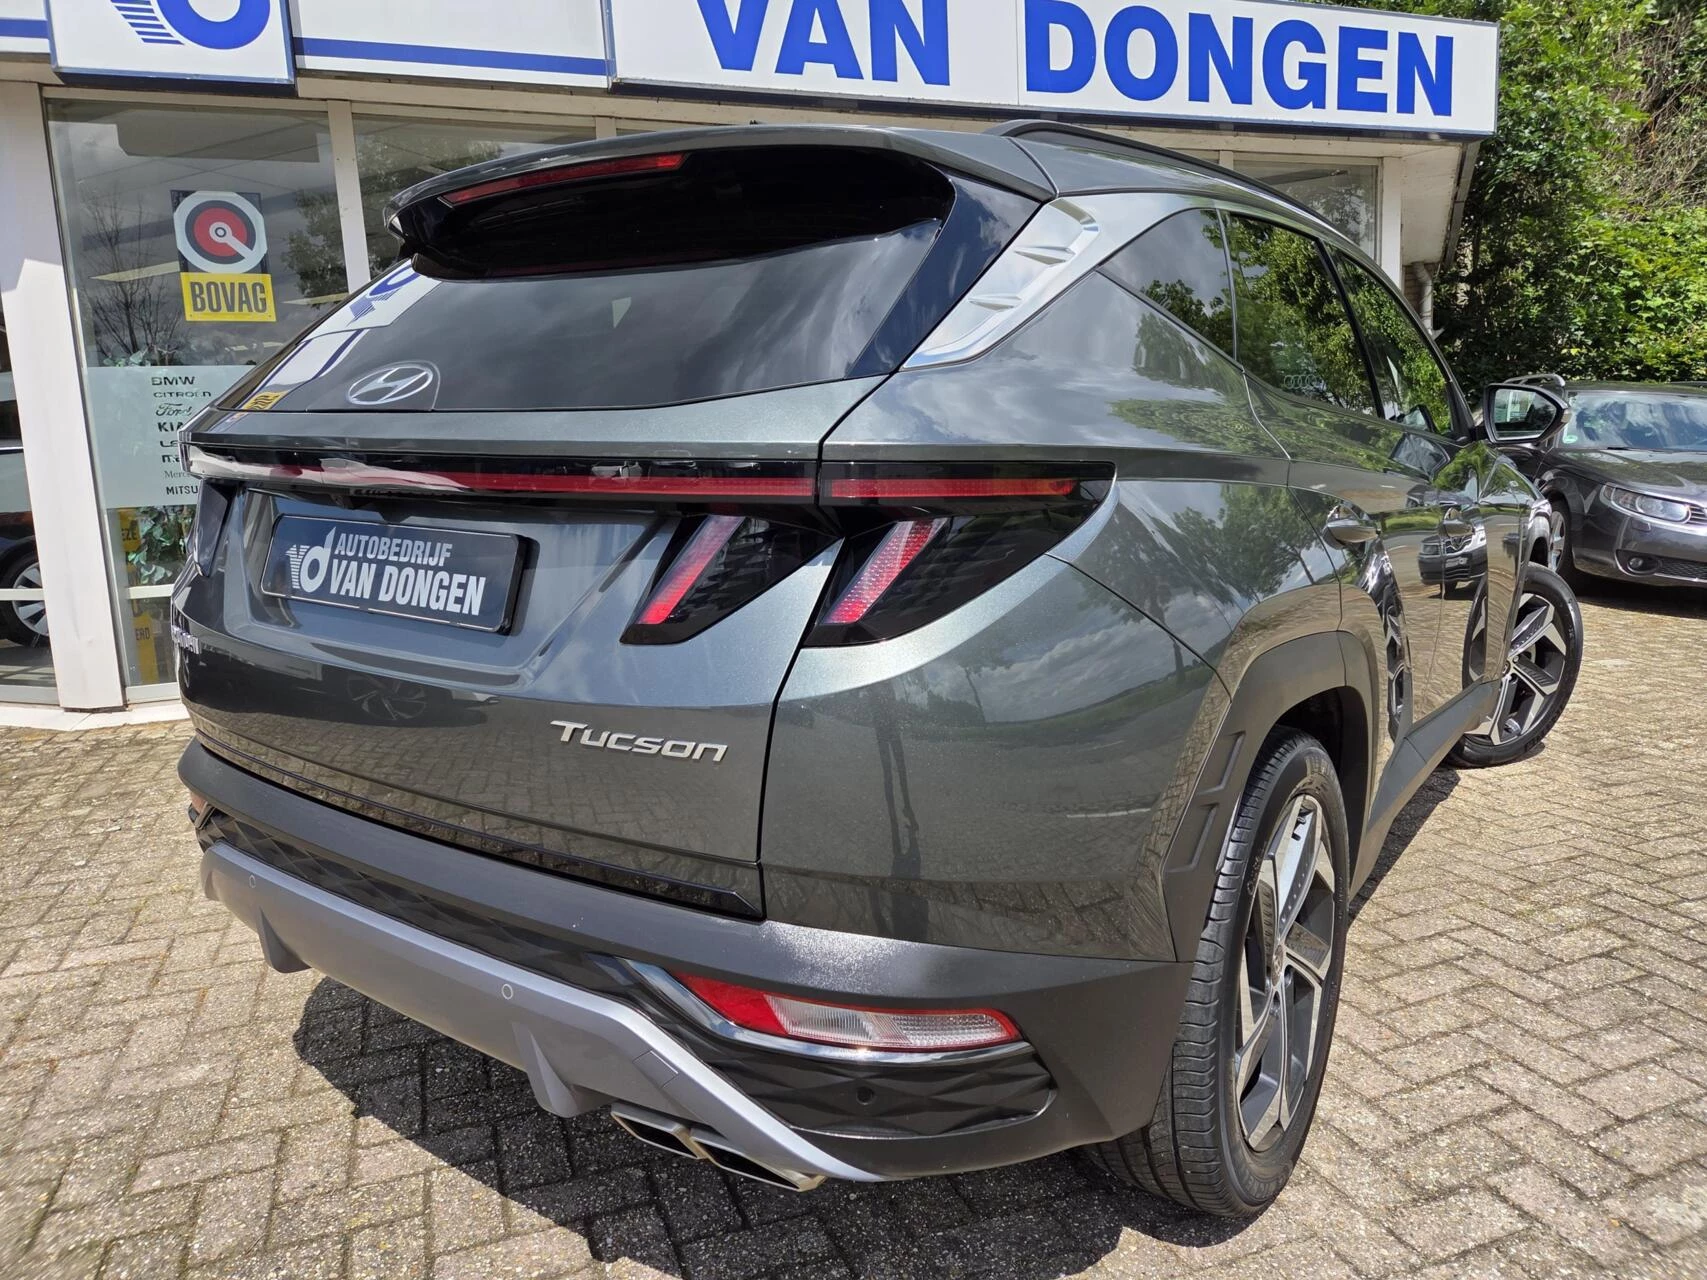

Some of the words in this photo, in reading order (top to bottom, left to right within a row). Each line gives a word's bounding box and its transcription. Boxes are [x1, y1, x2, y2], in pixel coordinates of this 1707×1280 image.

[697, 0, 950, 86] VAN
[1025, 0, 1453, 116] DONGEN
[190, 281, 267, 313] BOVAG
[151, 376, 195, 386] BMW
[155, 403, 193, 417] Ford
[334, 533, 453, 567] AUTOBEDRIJF
[330, 559, 377, 600] VAN
[378, 565, 487, 616] DONGEN
[550, 720, 728, 762] Tucson
